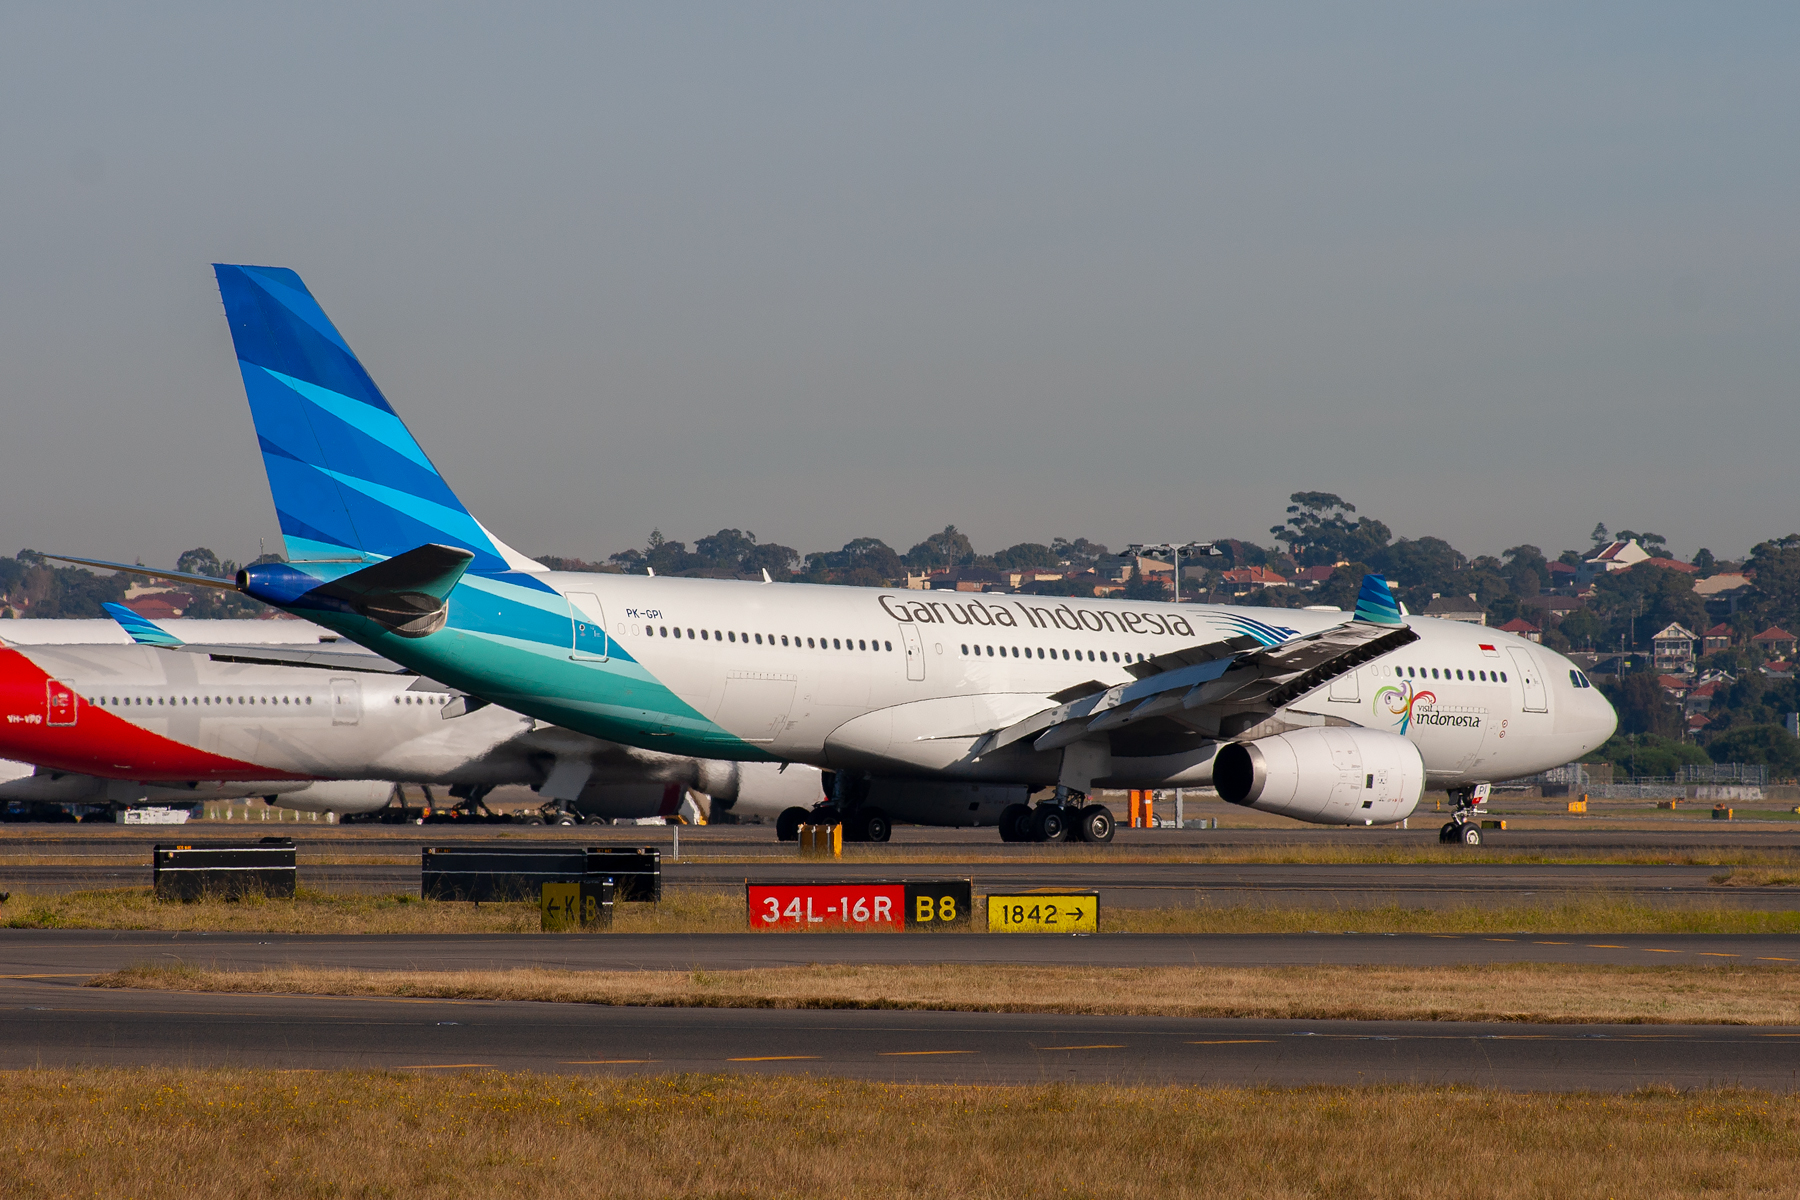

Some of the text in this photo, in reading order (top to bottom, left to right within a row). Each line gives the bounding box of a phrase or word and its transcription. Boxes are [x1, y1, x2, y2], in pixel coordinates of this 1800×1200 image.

[625, 608, 664, 620] PK-GPI
[877, 594, 1196, 637] Garuda Indonesia
[1416, 710, 1482, 728] indonesia
[564, 895, 575, 921] K
[761, 895, 957, 923] 34L-16R B8
[1002, 904, 1058, 925] 1842
